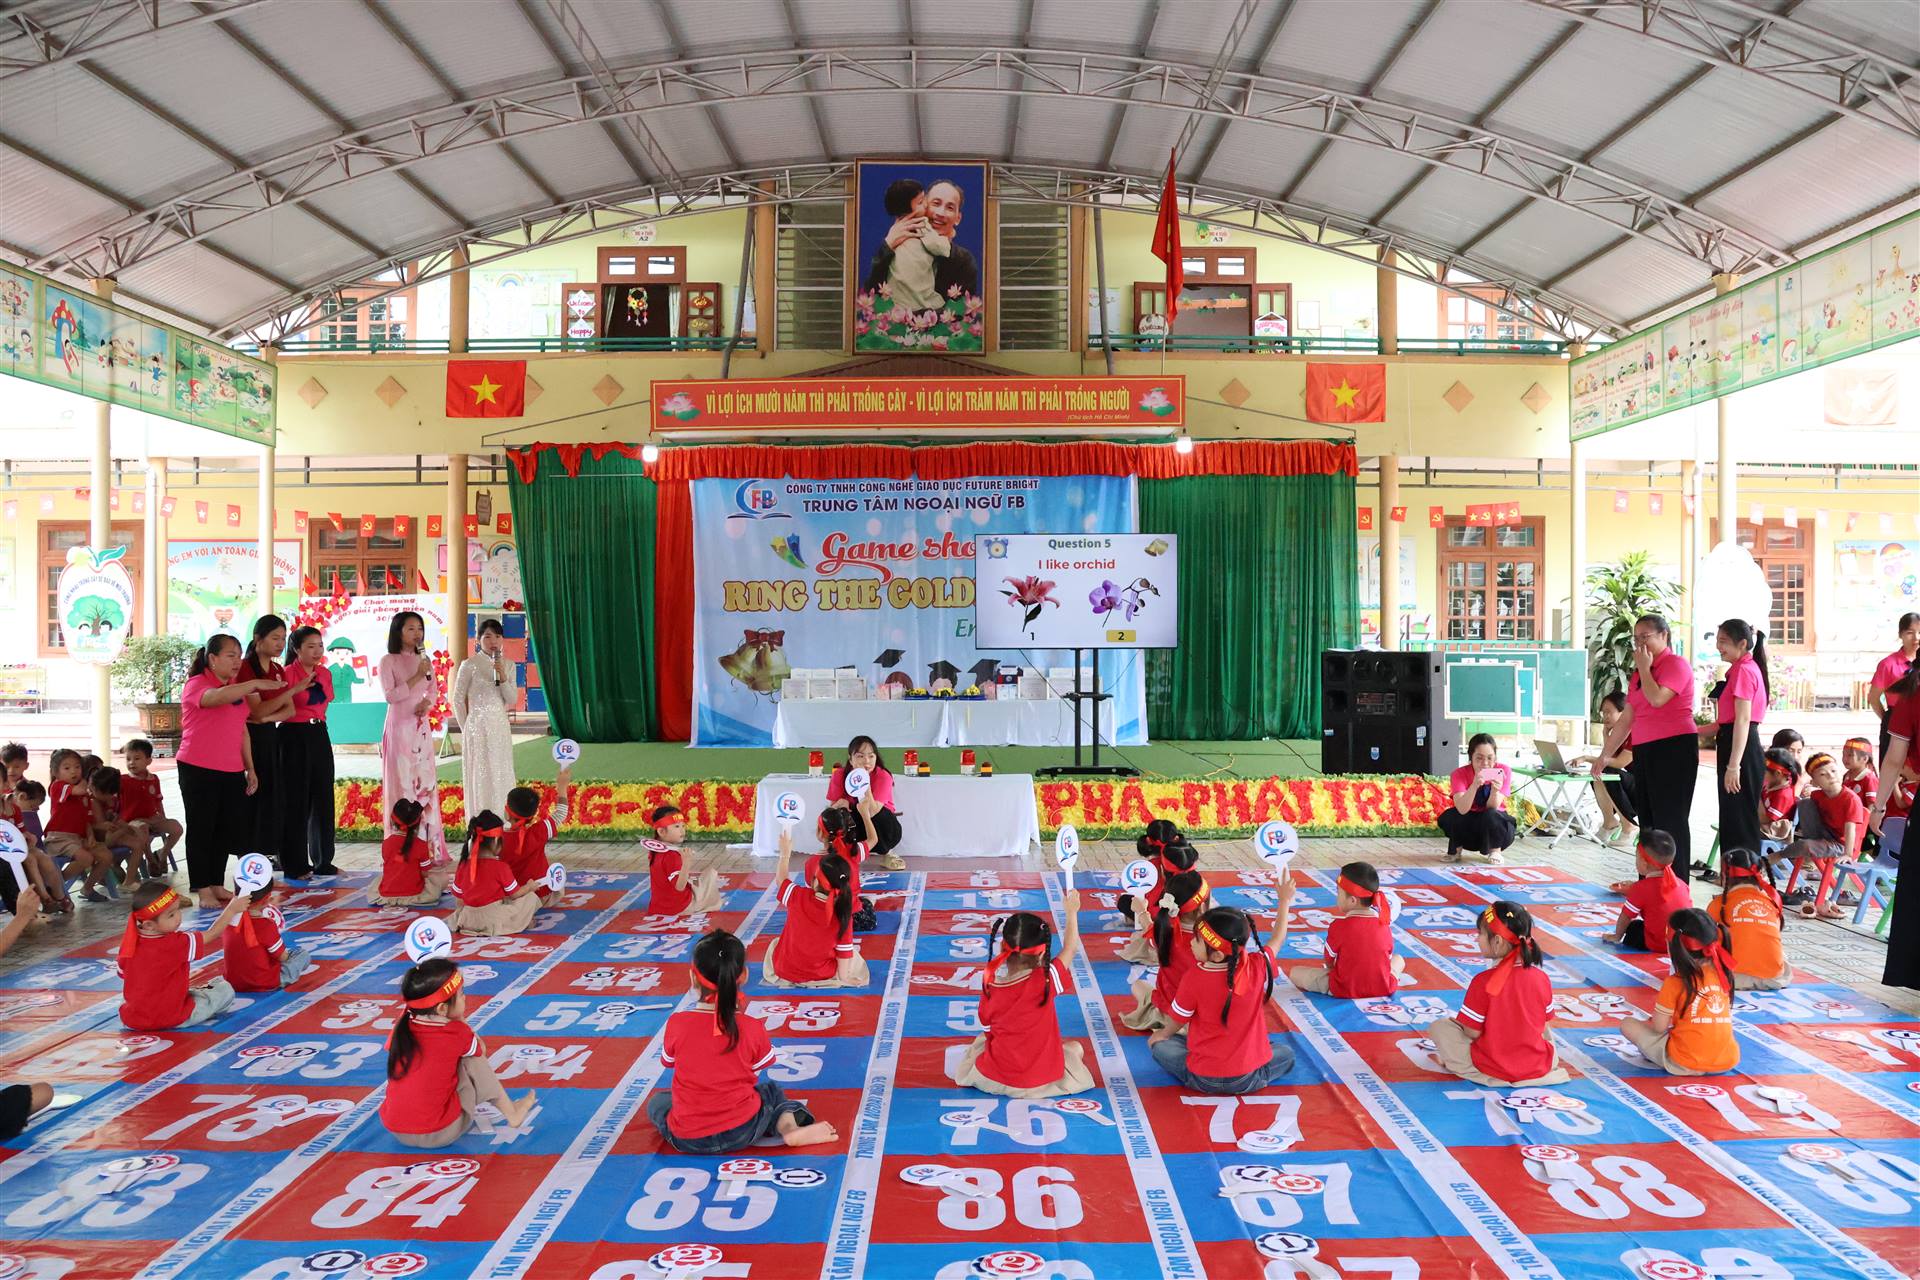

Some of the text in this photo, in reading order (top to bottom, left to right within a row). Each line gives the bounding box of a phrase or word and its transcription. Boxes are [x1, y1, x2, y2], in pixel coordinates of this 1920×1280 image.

[706, 390, 716, 414] VÌ
[718, 391, 733, 418] LỢI
[736, 390, 753, 413] ÍCH
[755, 388, 781, 413] MƯỜI
[783, 388, 806, 413] NĂM
[809, 388, 824, 413] THÌ
[827, 385, 850, 413] PHẢI
[887, 388, 907, 412] CÂY
[916, 387, 926, 412] VÌ
[928, 389, 944, 416] LỢI
[946, 387, 963, 412] ÍCH
[965, 387, 993, 412] TRĂM
[995, 387, 1019, 411] NĂM
[1021, 387, 1037, 411] THÌ
[1039, 384, 1062, 411] PHẢI
[1099, 386, 1130, 411] NGƯỜI
[816, 484, 827, 493] TY
[831, 483, 856, 493] TNHH
[859, 481, 886, 493] CÔNG
[889, 480, 914, 494] NGHỆ
[917, 480, 940, 491] GIÁO
[943, 481, 962, 493] DỤC
[966, 480, 1002, 491] FUTURE
[1006, 479, 1039, 490] BRIGHT
[751, 490, 776, 509] FB
[803, 493, 1025, 513] TRUNG TÂM NGOẠI NGỮ FB
[1048, 539, 1112, 550] Question 5
[815, 531, 976, 584] Game sho
[1038, 559, 1116, 569] I like orchid
[722, 577, 976, 612] RING THE GOLD
[1030, 632, 1035, 641] 1
[1118, 631, 1125, 641] 2
[1267, 829, 1287, 846] FB
[1133, 867, 1149, 879] FB
[524, 1002, 628, 1031] 54
[858, 1117, 880, 1135] TÂM
[939, 1098, 1068, 1147] 76
[1122, 1119, 1144, 1135] TÂM
[1179, 1094, 1306, 1144] 77
[1391, 1113, 1414, 1130] TÂM
[855, 1134, 876, 1159] TRUNG
[1131, 1135, 1153, 1160] TRUNG
[1404, 1129, 1438, 1154] TRUNG
[4, 1162, 211, 1229] 83
[311, 1165, 481, 1230] 84
[625, 1167, 779, 1232] 85
[936, 1165, 1085, 1232] 86
[1218, 1161, 1361, 1229] 87
[1522, 1155, 1707, 1221] 88
[219, 1187, 274, 1220] NGỮ FB
[490, 1188, 573, 1279] TÂM NGOẠI NGỮ FB
[825, 1189, 868, 1280] TÂM NGOẠI NGỮ FB
[1146, 1189, 1196, 1280] TÂM NGOẠI NGỮ FB
[1449, 1182, 1545, 1271] TÂM NGOẠI NGỮ FB
[680, 1249, 706, 1261] 2
[1278, 1237, 1296, 1249] 1
[323, 1255, 342, 1268] 1
[1000, 1256, 1027, 1270] 2
